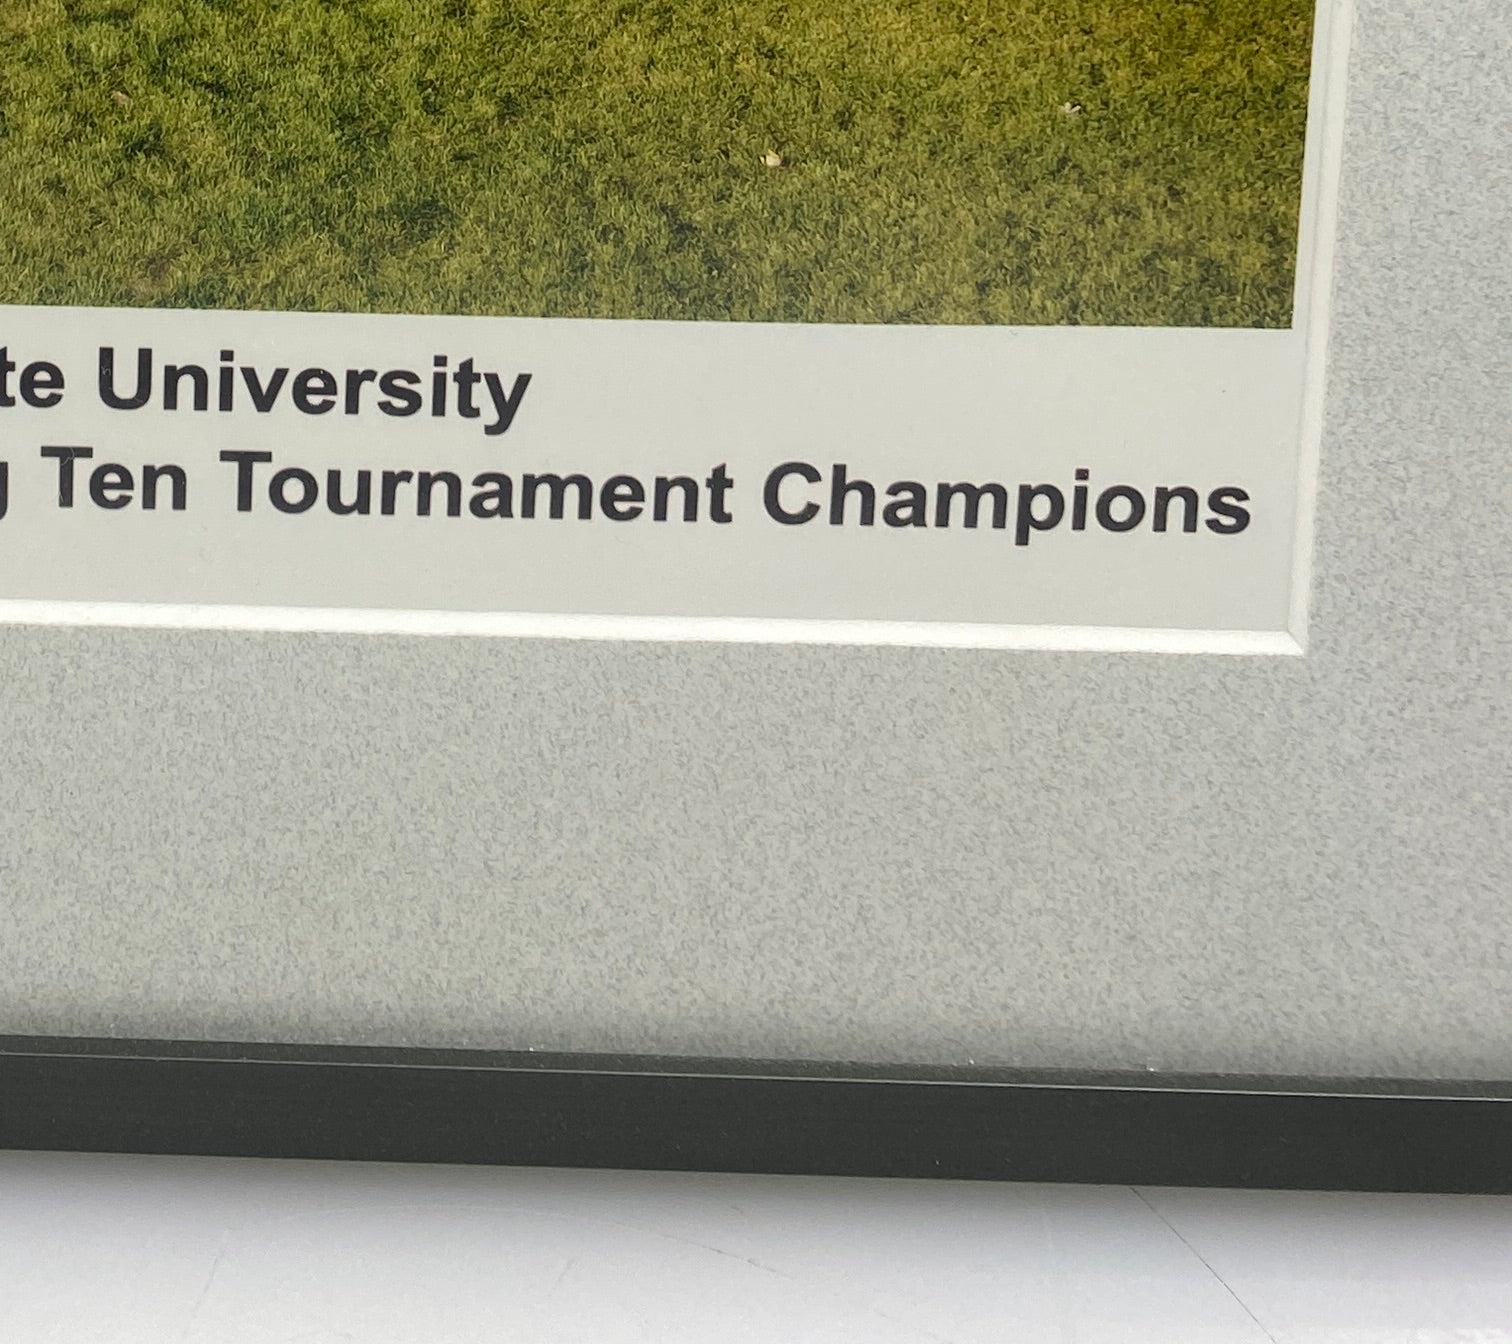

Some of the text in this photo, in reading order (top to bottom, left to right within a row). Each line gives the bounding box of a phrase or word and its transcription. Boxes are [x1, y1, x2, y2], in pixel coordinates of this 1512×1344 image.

[98, 346, 533, 436] University
[40, 445, 187, 511] Ten
[219, 450, 734, 524] Tournament
[763, 461, 1251, 535] Champions
